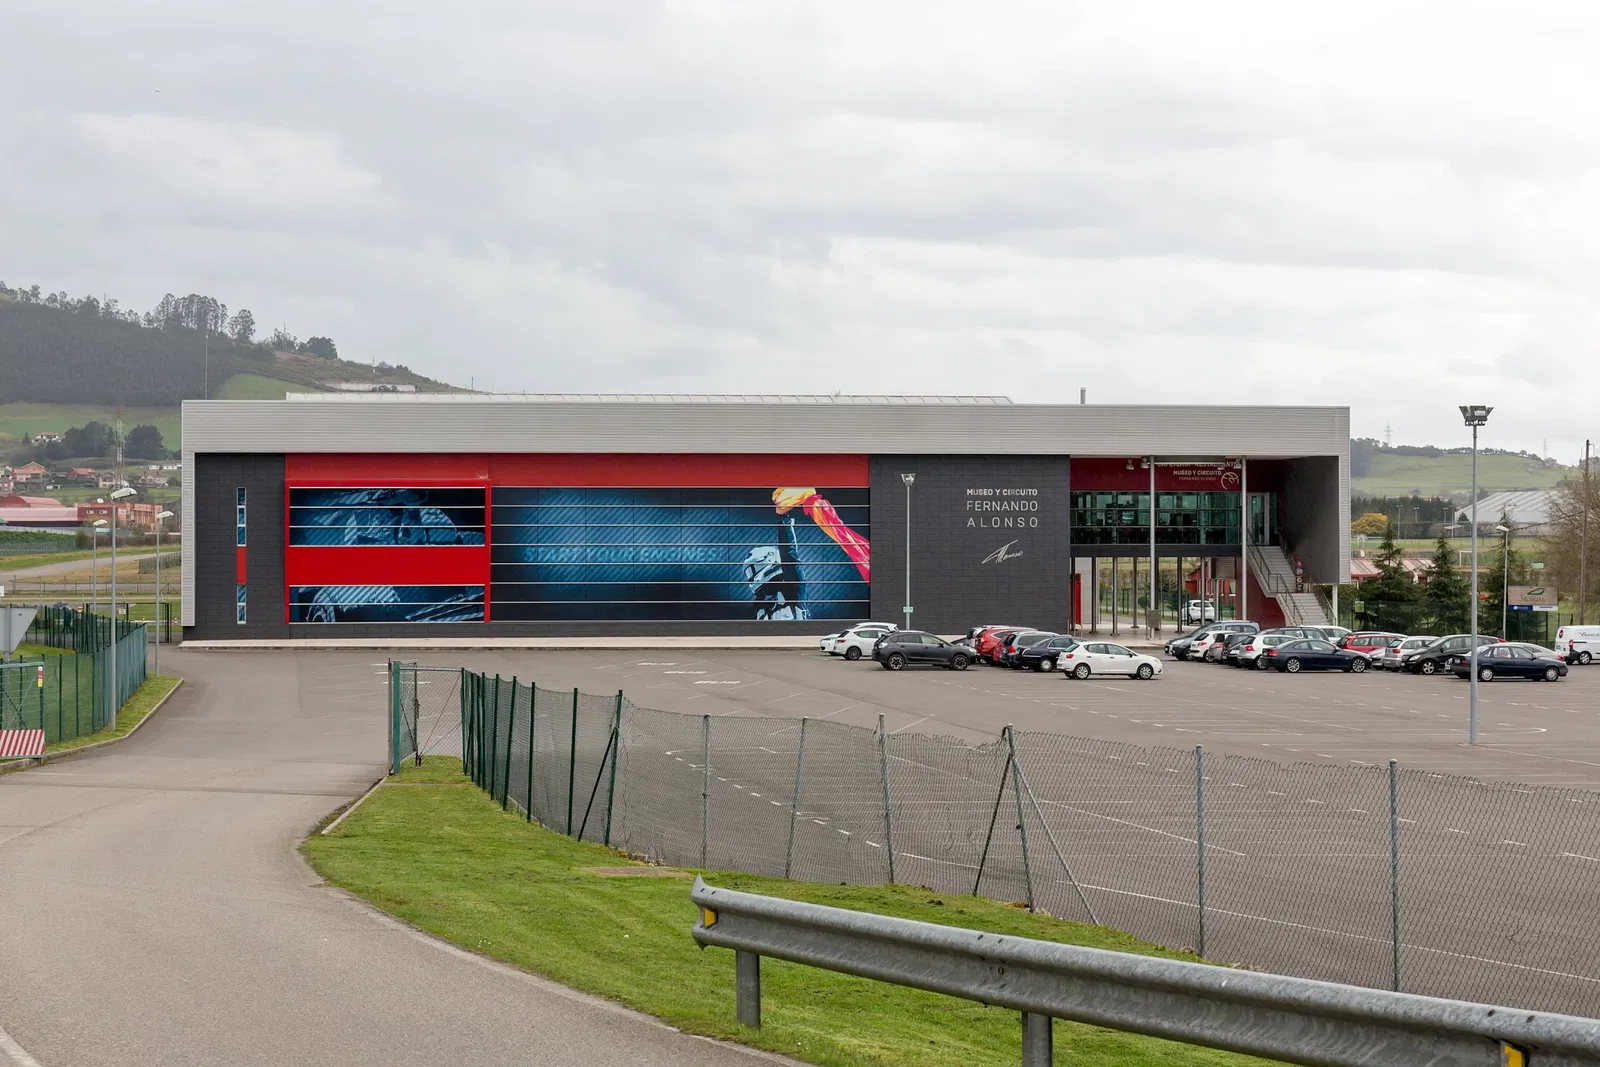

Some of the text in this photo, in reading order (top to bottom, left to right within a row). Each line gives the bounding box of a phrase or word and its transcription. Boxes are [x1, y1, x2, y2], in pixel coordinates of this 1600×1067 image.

[966, 488, 1038, 496] MUSEO Y CIRCUITO
[966, 500, 1038, 511] FERNANDO
[966, 516, 1038, 528] ALONSO
[524, 547, 586, 562] START
[586, 547, 634, 562] YOUR
